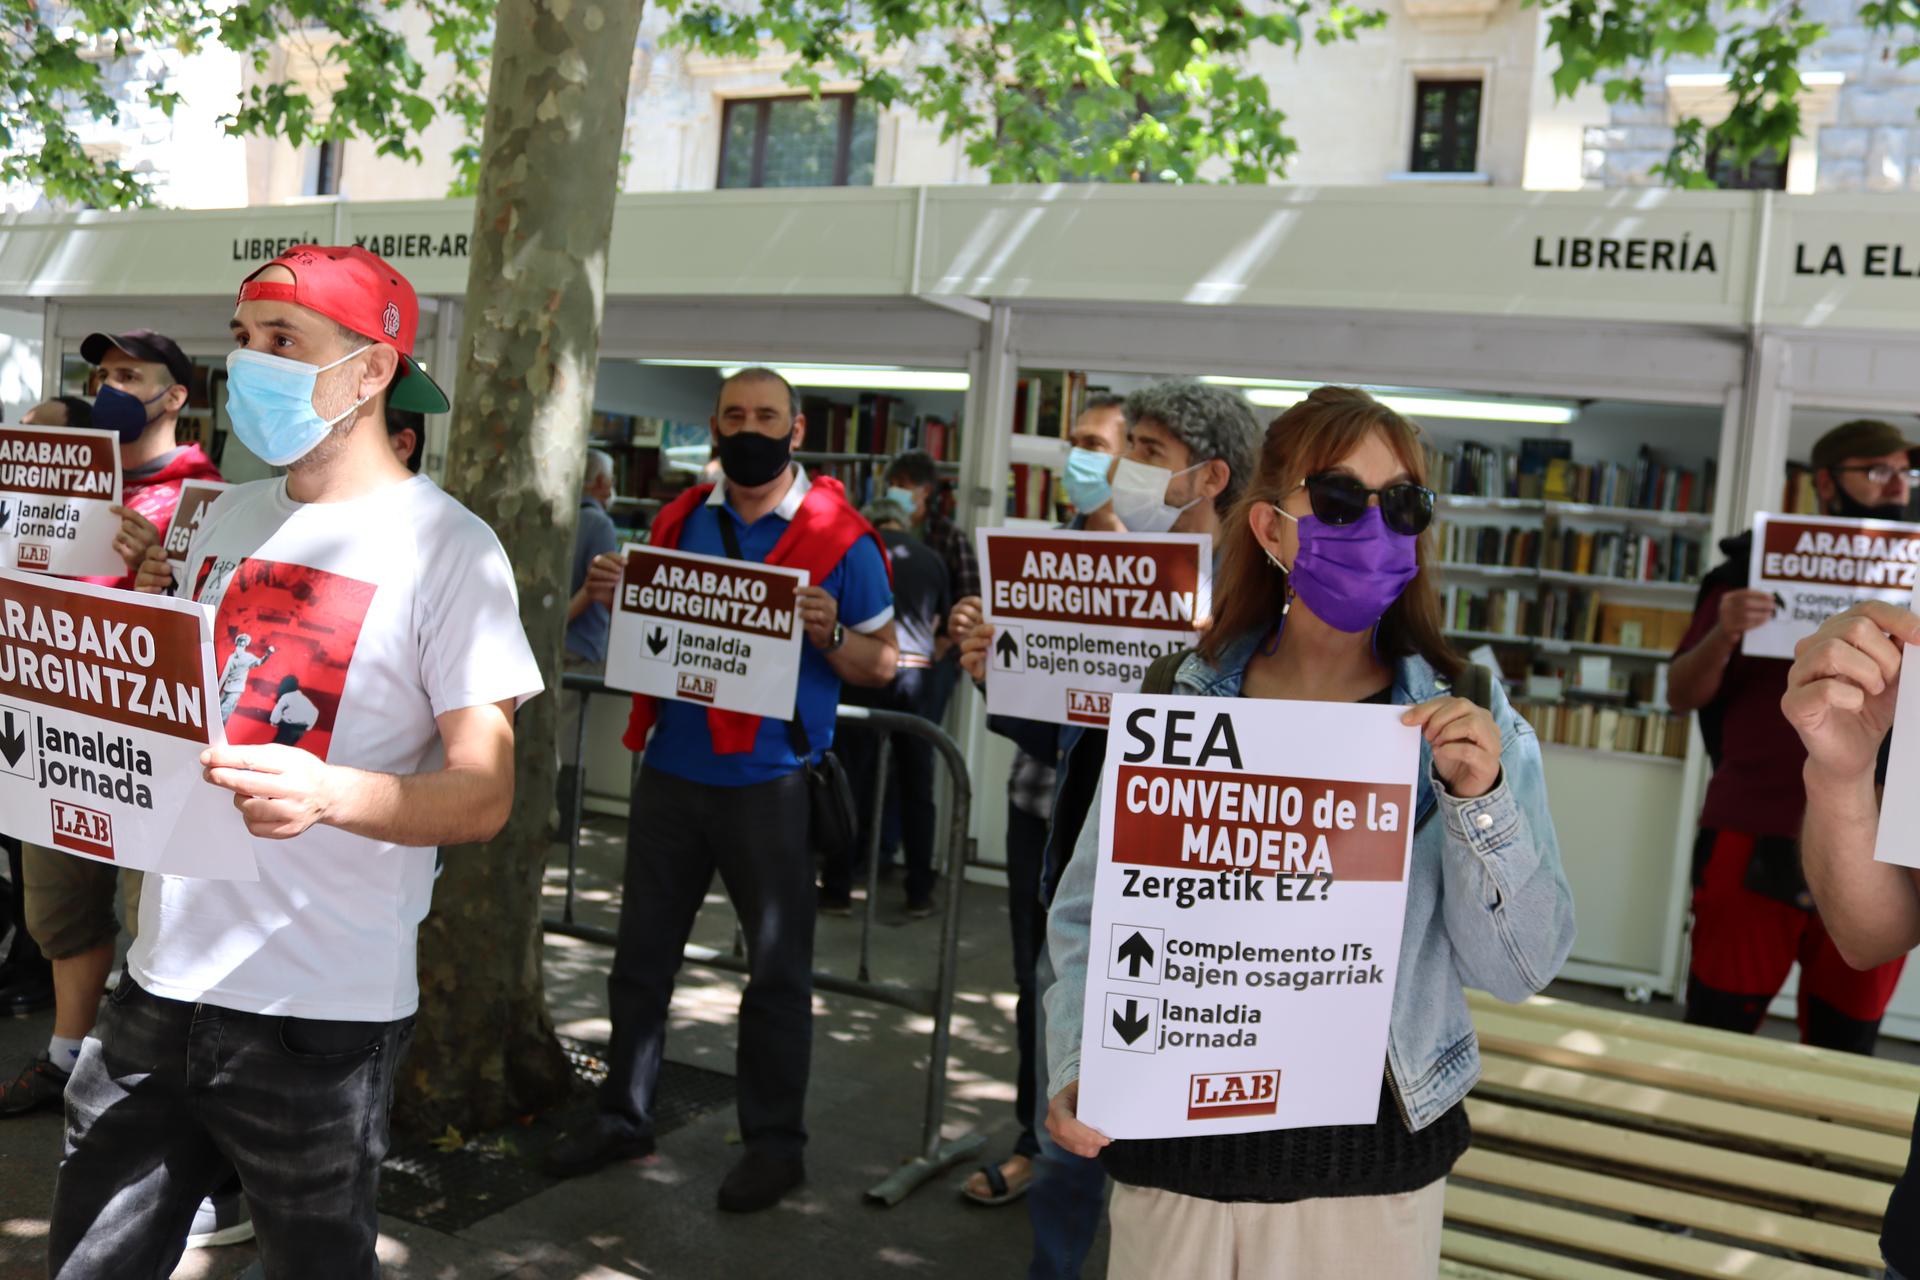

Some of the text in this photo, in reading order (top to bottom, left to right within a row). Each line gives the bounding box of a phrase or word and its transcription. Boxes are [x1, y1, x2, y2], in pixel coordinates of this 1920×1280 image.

[1534, 232, 1717, 273] LIBRERÍA
[1794, 243, 1920, 277] LA EL
[0, 440, 92, 468] ARABAKO
[18, 501, 80, 523] lanaldia
[14, 517, 76, 540] jornada
[20, 544, 49, 562] LAB
[1795, 531, 1920, 562] ARABAKO
[652, 564, 767, 603] ARABAKO
[1022, 550, 1157, 586] ARABAKO
[624, 584, 791, 634] EGURGINTZAN
[995, 580, 1194, 622] EGURGINTZAN
[678, 628, 751, 658] lanaldia
[1026, 632, 1161, 660] complemento
[673, 647, 747, 676] jornada
[1026, 650, 1079, 674] bajen
[680, 676, 714, 694] LAB
[1070, 692, 1110, 713] LAB
[37, 716, 153, 776] lanaldia
[1123, 707, 1243, 769] SEA
[38, 750, 153, 809] jornada
[1126, 775, 1399, 832] CONVENIO de la
[55, 805, 111, 843] LAB
[1181, 823, 1333, 872] MADERA
[1122, 869, 1333, 909] Zergatik EZ?
[1166, 938, 1373, 963] complemento ITs
[1164, 958, 1384, 991] bajen osagarriak
[1162, 999, 1262, 1024] lanaldia
[1158, 1024, 1258, 1050] jornada
[1195, 1074, 1274, 1104] LAB
